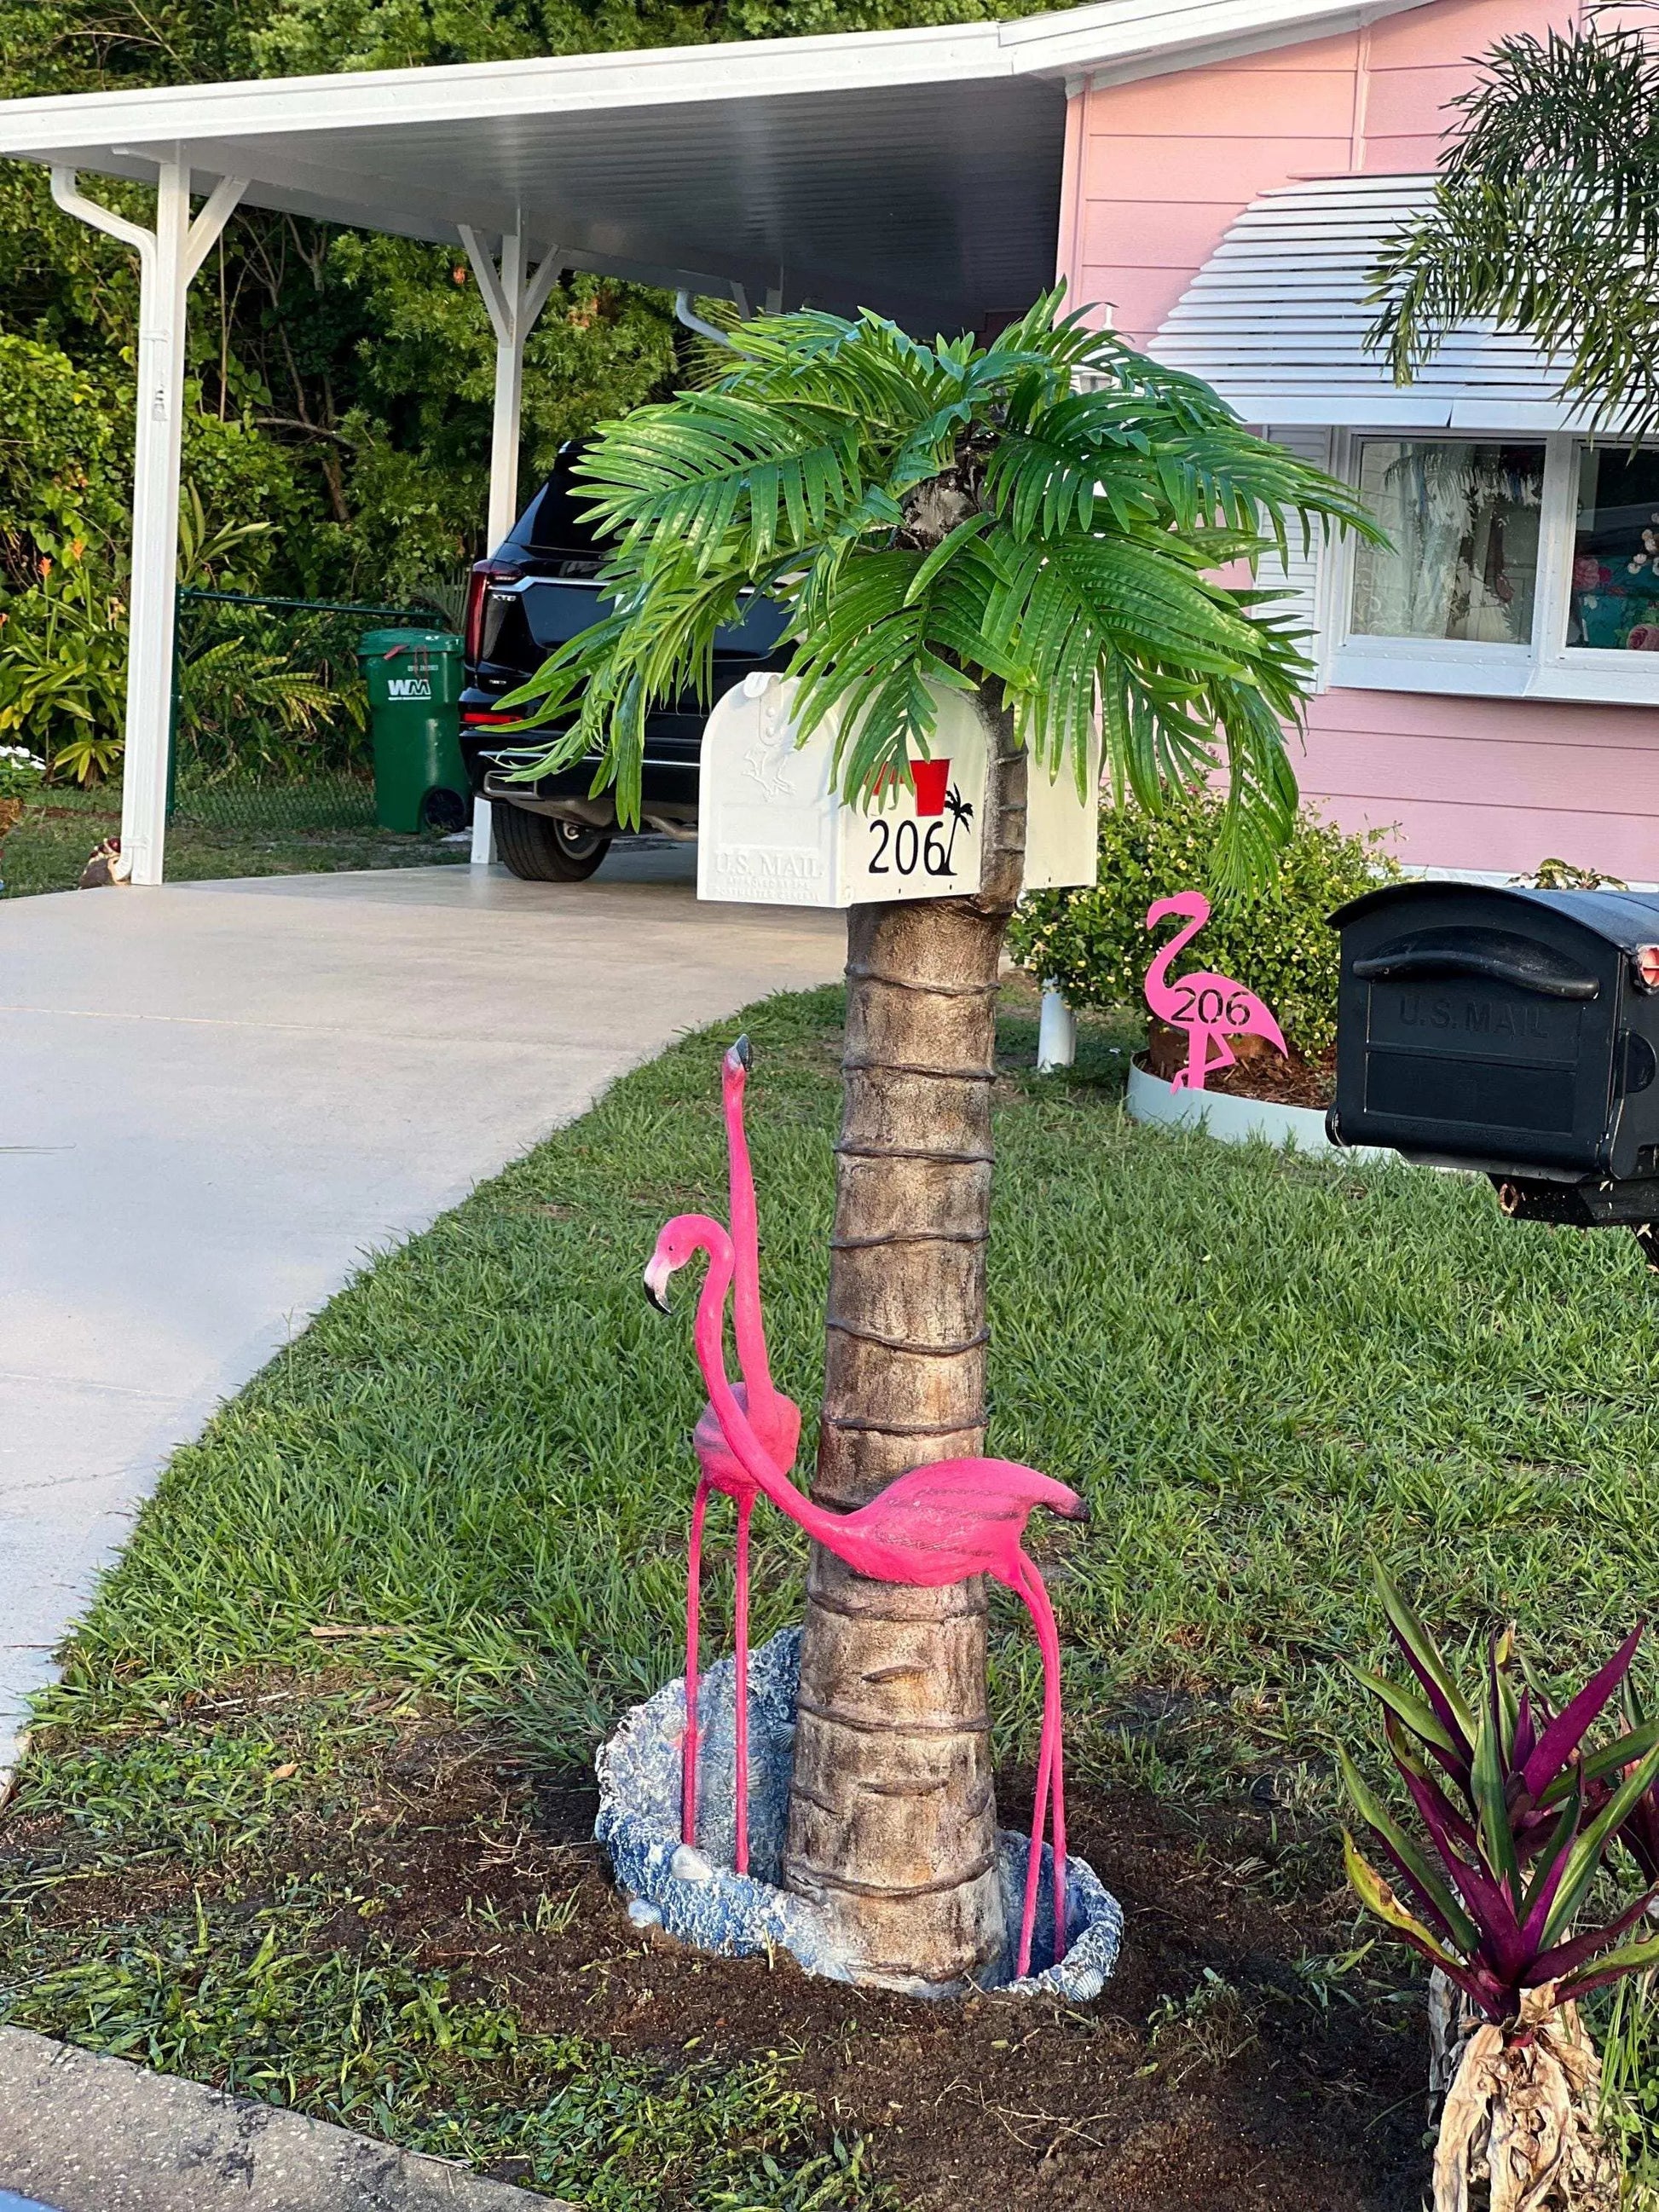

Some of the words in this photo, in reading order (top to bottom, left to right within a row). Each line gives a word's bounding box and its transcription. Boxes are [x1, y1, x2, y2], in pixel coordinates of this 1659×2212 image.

[388, 679, 431, 696] WM
[715, 852, 753, 875] U.S.
[760, 852, 824, 879] MAIL
[869, 819, 945, 875] 206
[1171, 986, 1251, 1026] 206
[1399, 996, 1457, 1030] U.S.
[1465, 1001, 1548, 1038] MAIL
